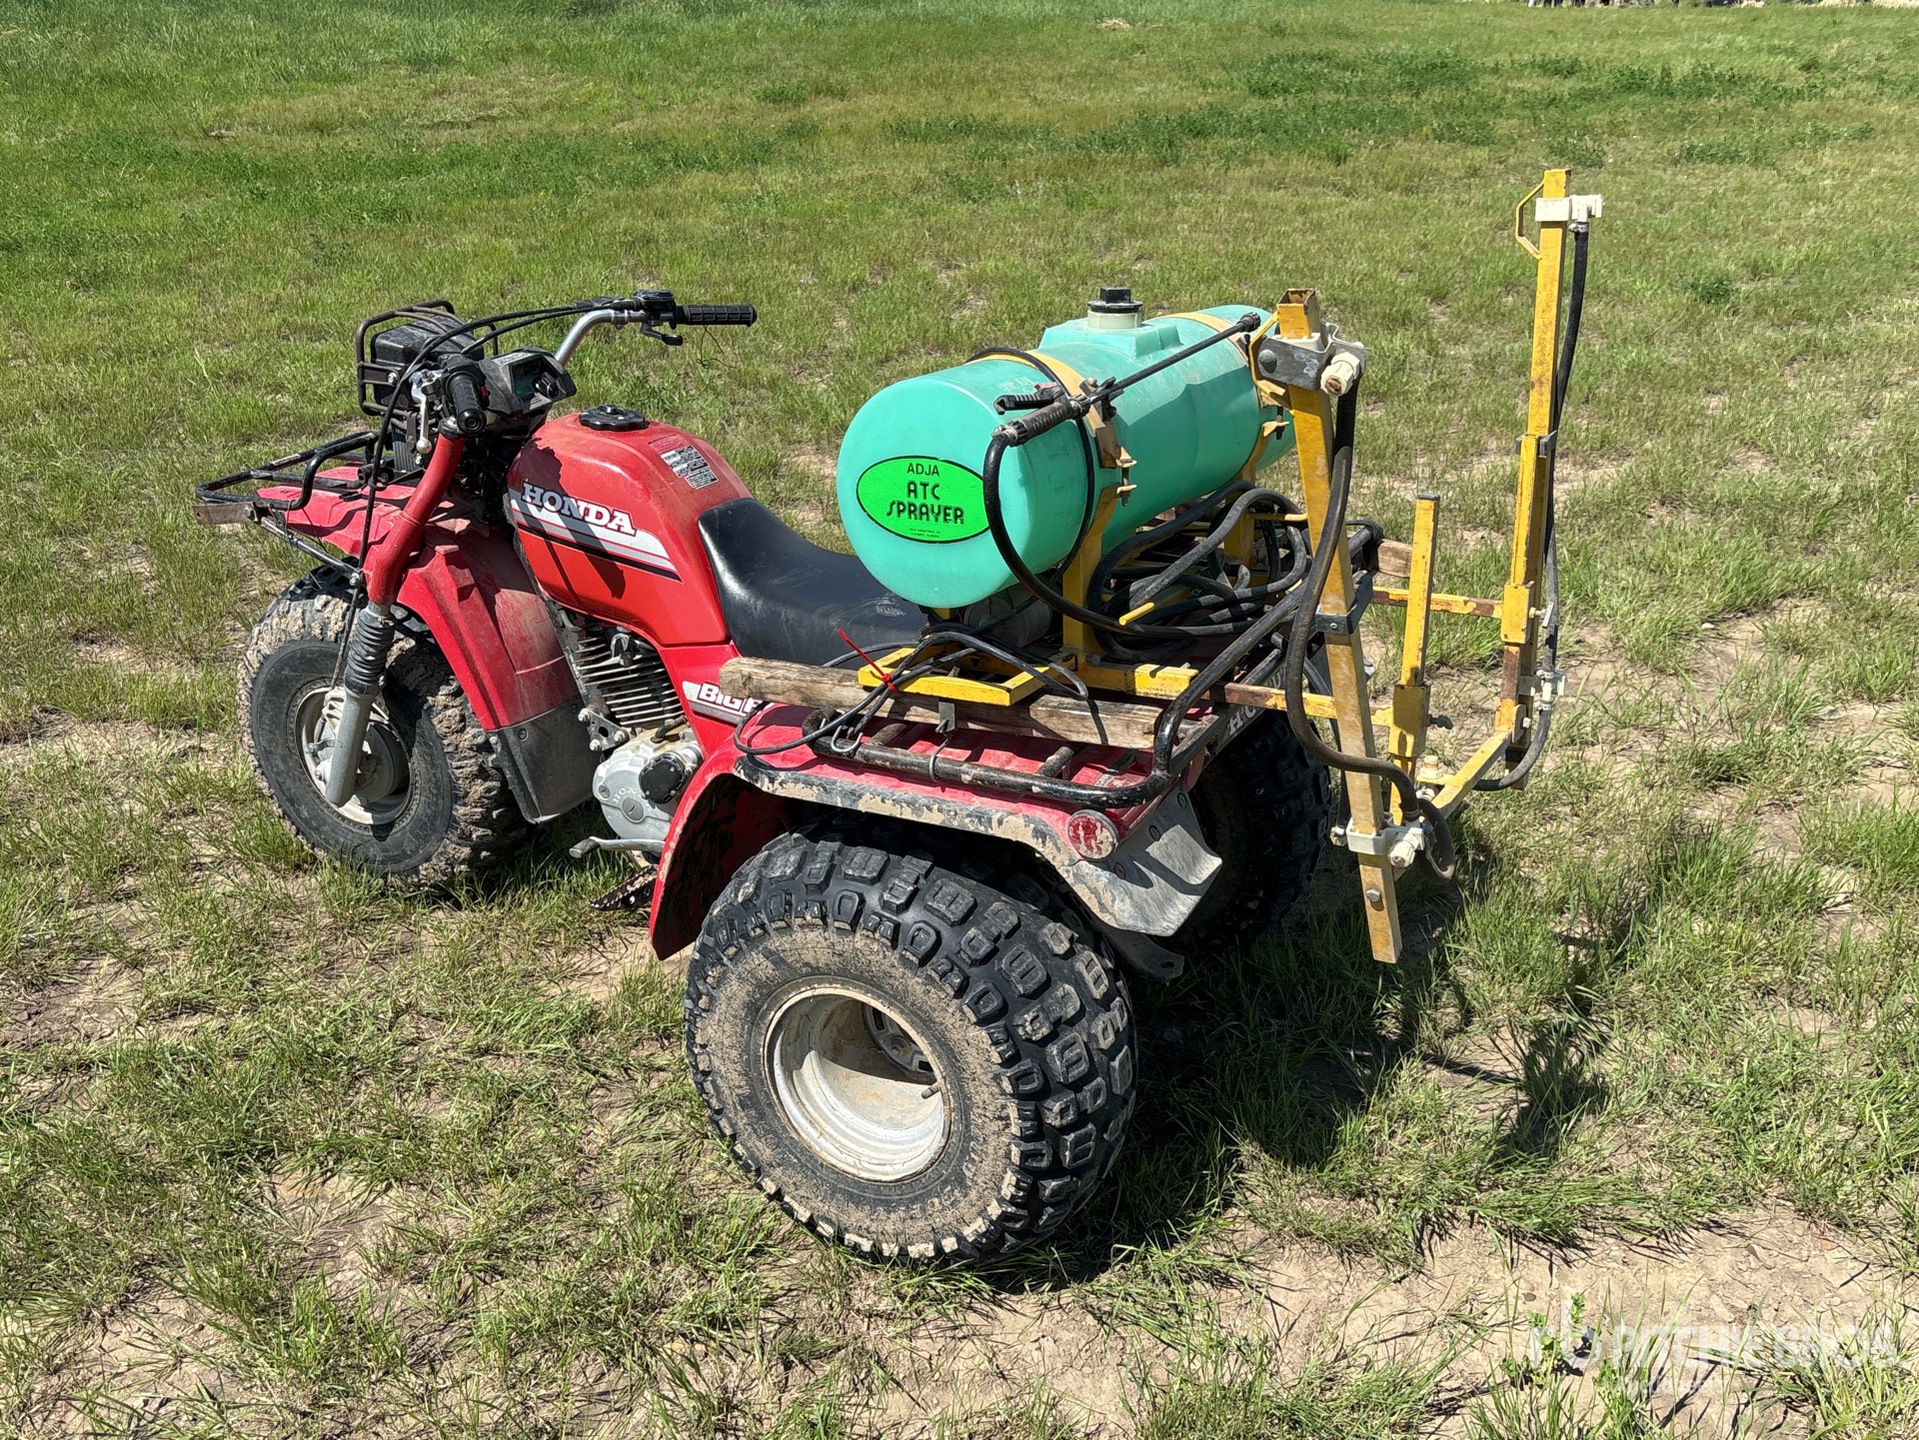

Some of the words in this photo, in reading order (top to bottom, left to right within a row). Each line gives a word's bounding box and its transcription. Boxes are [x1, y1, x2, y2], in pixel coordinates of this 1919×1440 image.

[907, 463, 940, 477] ADJA
[907, 480, 940, 500] ATC
[522, 481, 637, 536] HONDA
[886, 500, 965, 525] SPRAYER
